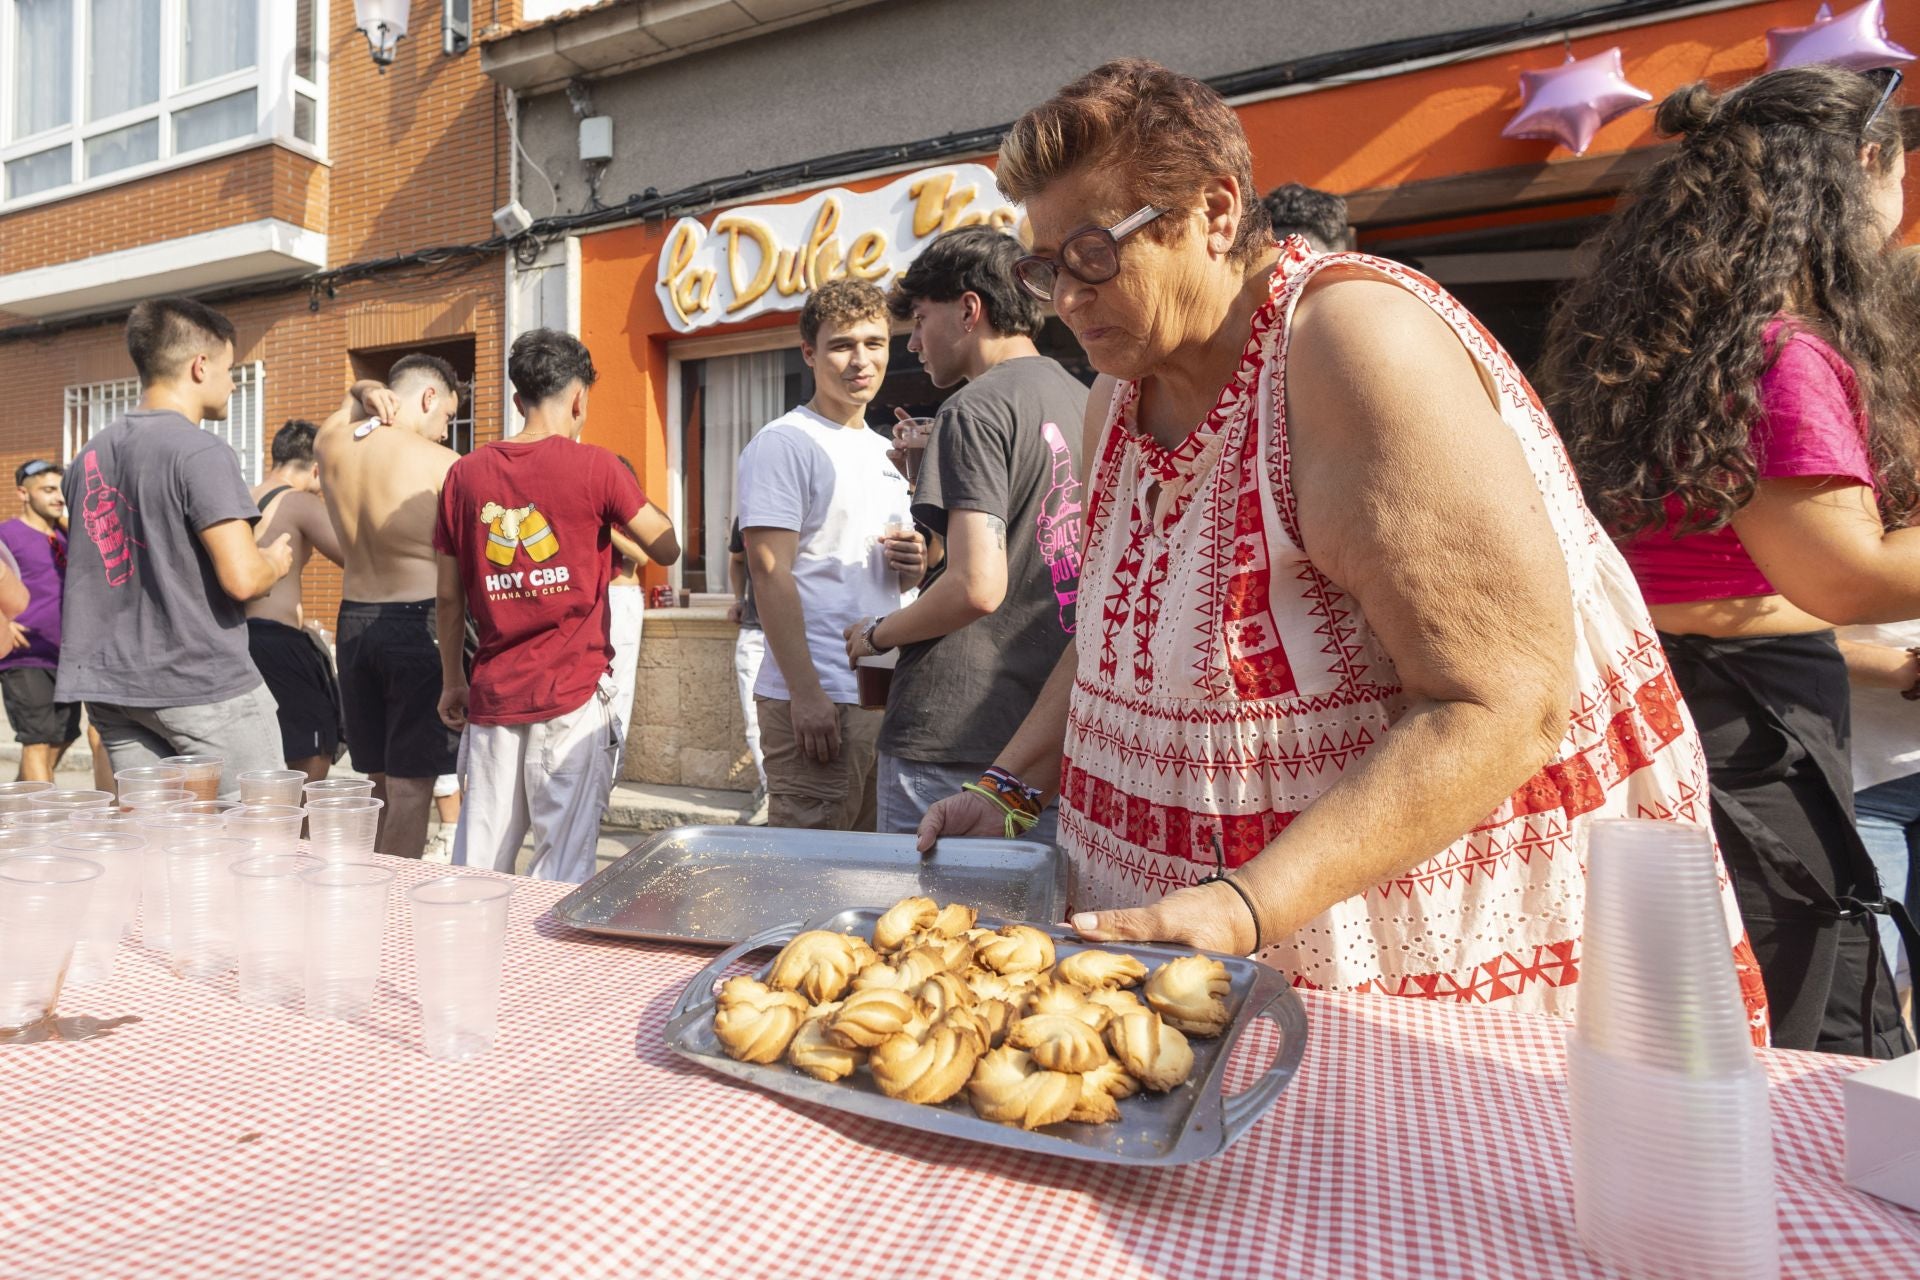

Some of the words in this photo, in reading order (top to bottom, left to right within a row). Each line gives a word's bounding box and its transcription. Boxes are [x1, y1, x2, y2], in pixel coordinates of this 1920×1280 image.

[716, 195, 890, 315] Dulce
[485, 571, 524, 592] HOY
[529, 566, 570, 586] CBB
[489, 592, 520, 601] VIANA
[525, 590, 538, 598] DE
